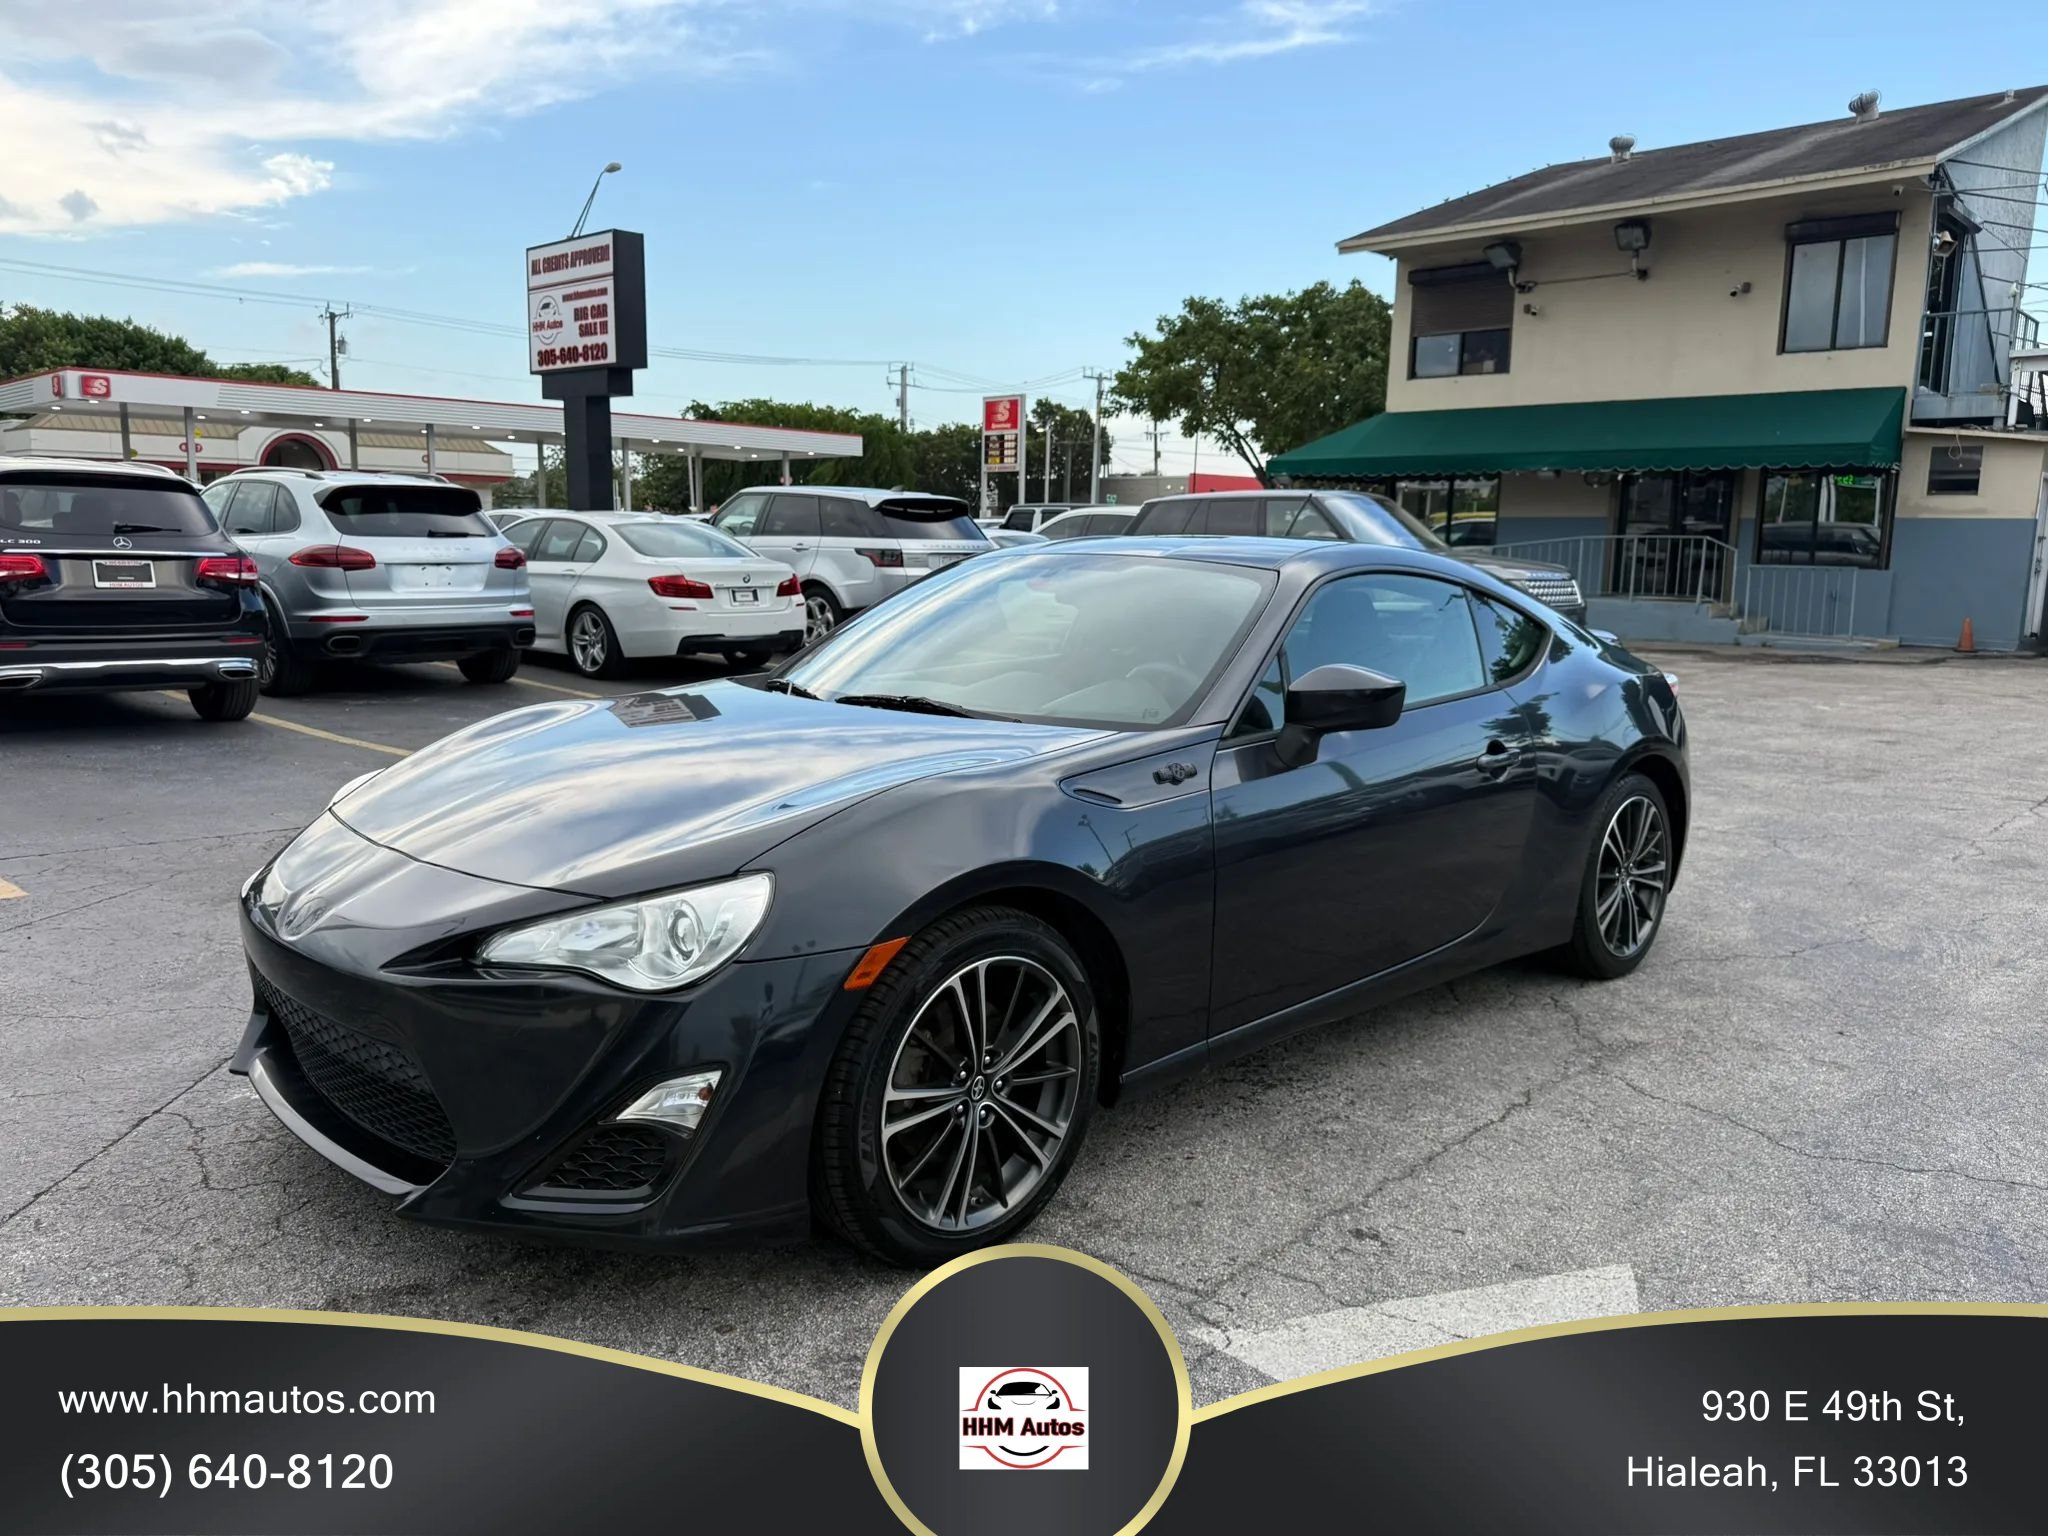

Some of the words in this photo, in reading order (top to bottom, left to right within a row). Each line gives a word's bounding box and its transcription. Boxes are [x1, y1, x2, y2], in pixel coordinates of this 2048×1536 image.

[573, 306, 589, 322] BIG
[590, 303, 608, 320] CAR
[578, 321, 598, 337] SALE
[537, 342, 608, 367] 305-640-8120
